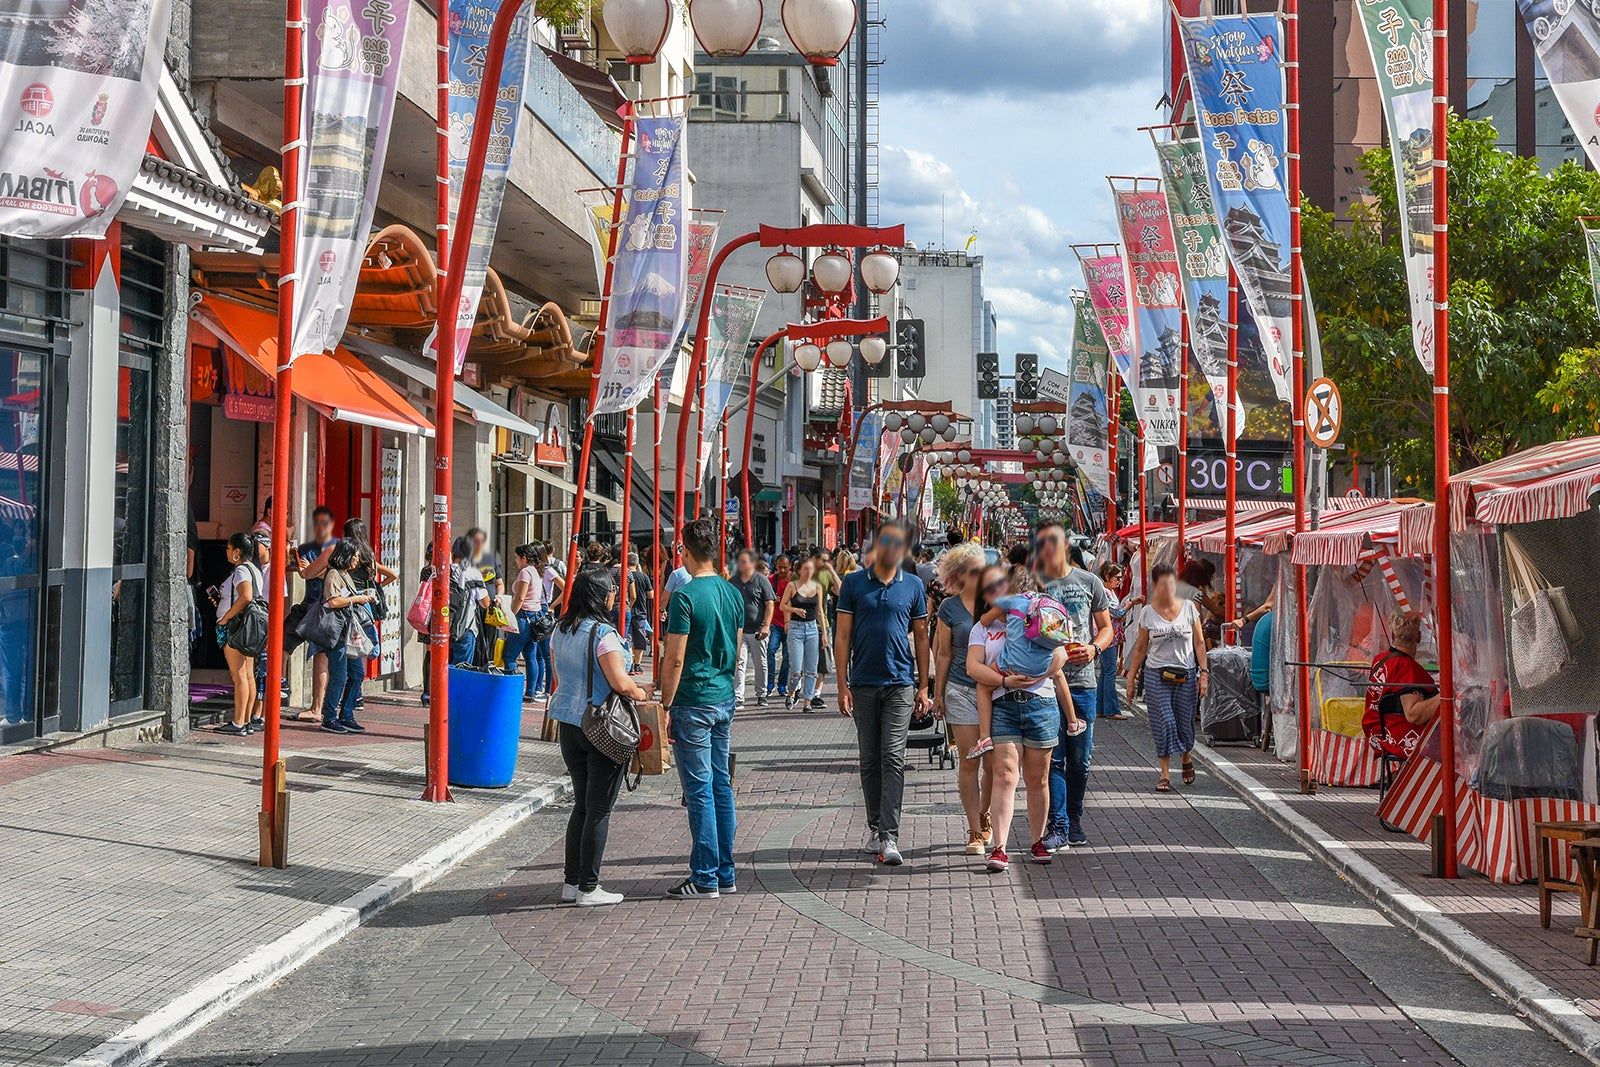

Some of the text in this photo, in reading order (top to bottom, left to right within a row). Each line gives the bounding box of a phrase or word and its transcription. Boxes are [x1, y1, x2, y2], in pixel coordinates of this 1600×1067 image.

[1378, 8, 1403, 45] 子
[1216, 43, 1255, 62] Matsuri
[1387, 48, 1408, 64] 2020
[1219, 69, 1254, 106] 祭
[1202, 110, 1235, 127] Boas
[1213, 131, 1236, 160] 子
[1189, 182, 1212, 211] 祭
[1141, 224, 1164, 249] 祭
[1107, 284, 1124, 305] 祭
[1150, 419, 1178, 430] NIKKEY
